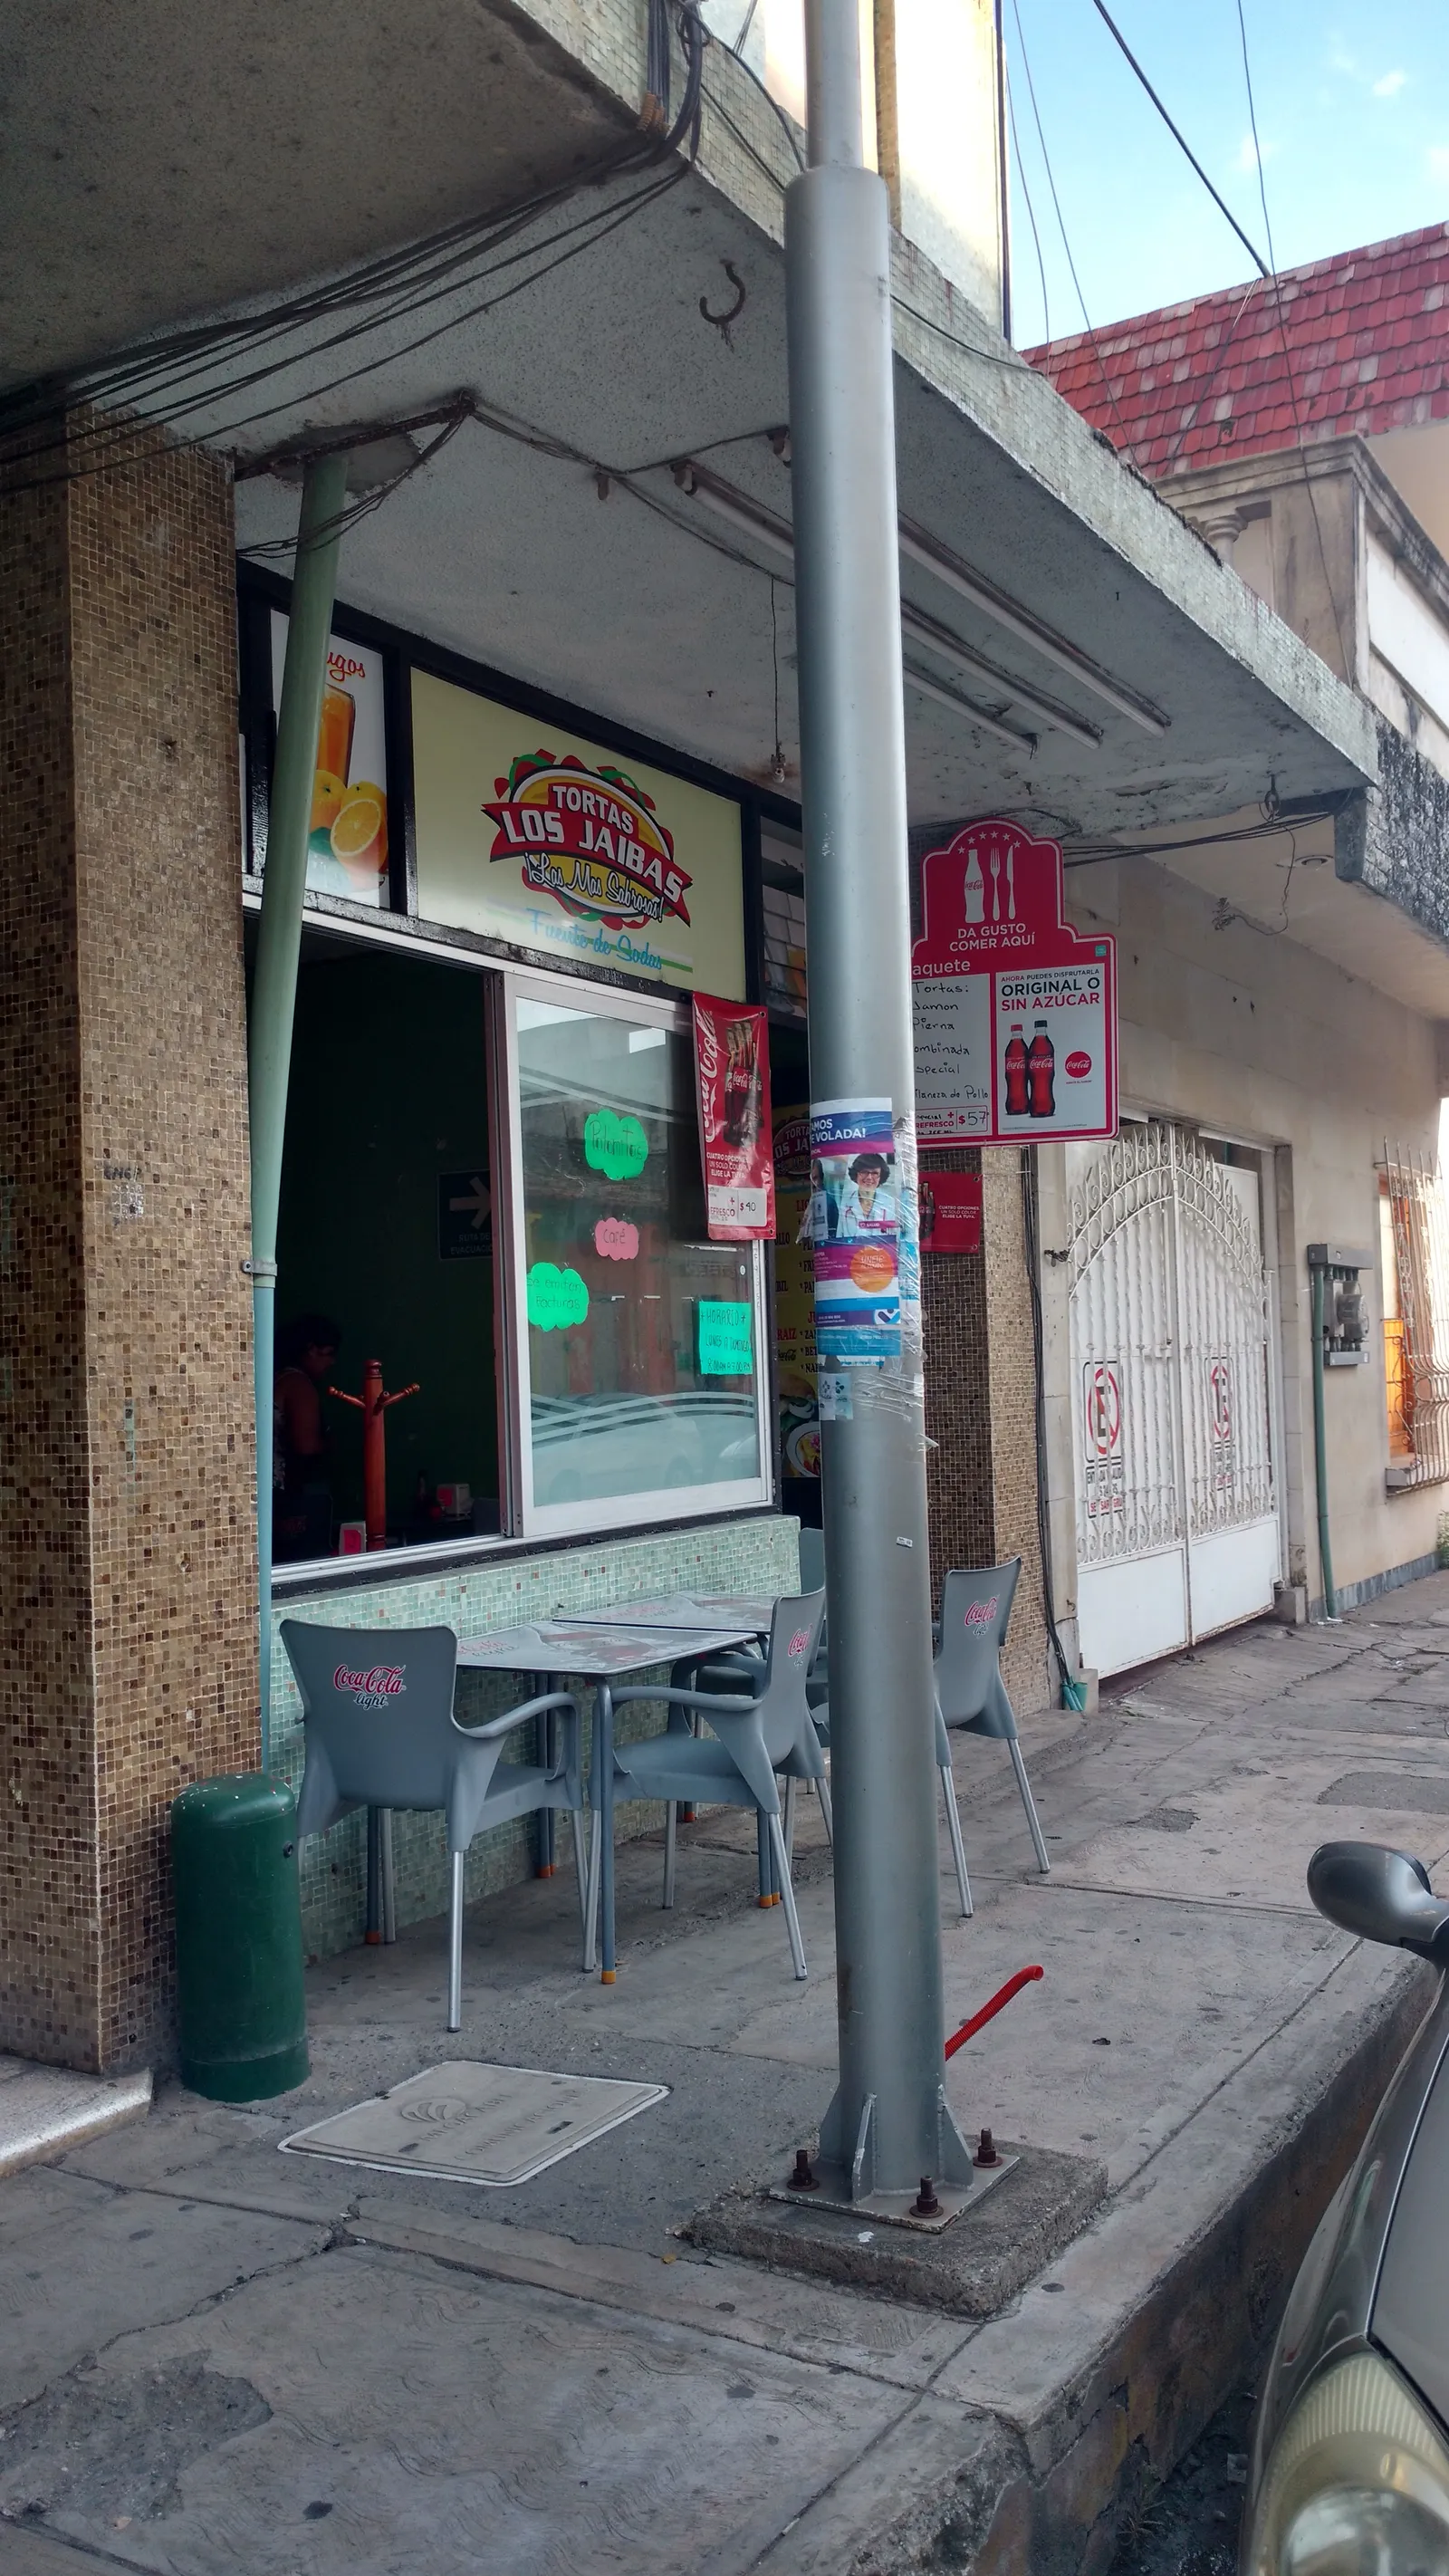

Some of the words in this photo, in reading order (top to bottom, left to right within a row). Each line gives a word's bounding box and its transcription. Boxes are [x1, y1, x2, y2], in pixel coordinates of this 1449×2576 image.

[552, 785, 634, 835] TORTAS
[502, 810, 565, 844] LOS
[579, 820, 684, 903] JAIBAS
[566, 860, 603, 899] Mas
[526, 907, 589, 950] Fuente
[593, 928, 612, 956] de
[616, 934, 663, 971] Sodas
[957, 928, 976, 939] DA
[980, 922, 1026, 937] GUSTO
[949, 938, 997, 952] COMER
[1001, 931, 1035, 948] AQUÍ
[912, 959, 971, 977] aquete
[1053, 968, 1099, 977] DISFRUTARLA
[912, 981, 969, 994] Tortas:
[1001, 979, 1082, 996] ORIGINAL
[1087, 976, 1100, 989] O
[1001, 998, 1027, 1011] SIN
[1032, 990, 1100, 1009] AZÚCAR
[914, 1042, 970, 1055] ombinada
[916, 1062, 960, 1075] special
[915, 1088, 947, 1100] ilaneza
[964, 1084, 989, 1099] Pollo
[916, 1120, 955, 1129] REFRESCO
[958, 1115, 965, 1124] $
[815, 1127, 867, 1143] VOLADA!
[774, 1142, 791, 1160] OS
[794, 1138, 810, 1153] JA
[710, 1206, 735, 1217] EFRESCO
[602, 1228, 626, 1246] Café
[353, 1692, 389, 1711] light
